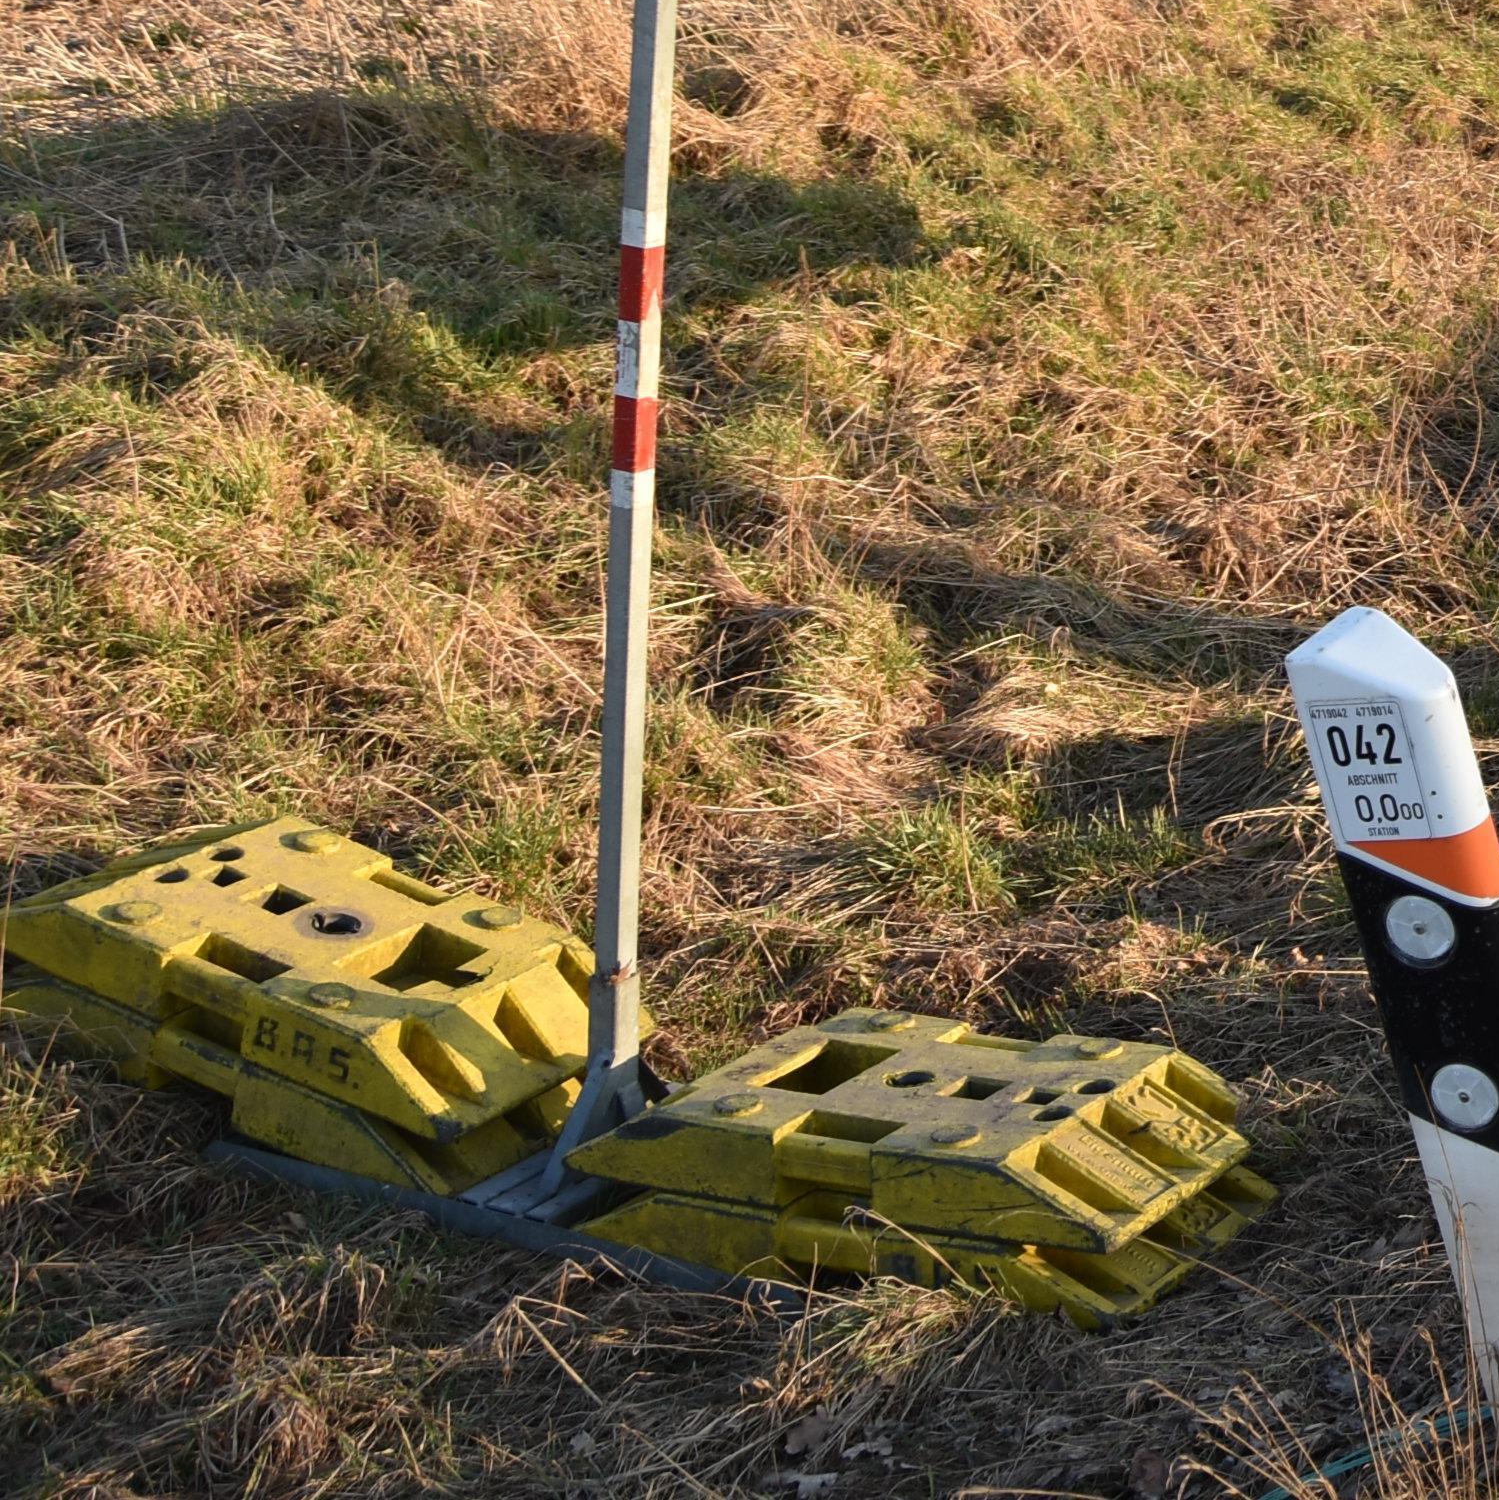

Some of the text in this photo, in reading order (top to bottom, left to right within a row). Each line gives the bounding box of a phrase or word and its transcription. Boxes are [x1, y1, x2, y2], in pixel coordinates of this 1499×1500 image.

[1355, 705, 1394, 718] 4719014
[1326, 722, 1403, 767] 042
[1347, 772, 1398, 786] ABSCHNITT
[1367, 826, 1400, 837] STATION
